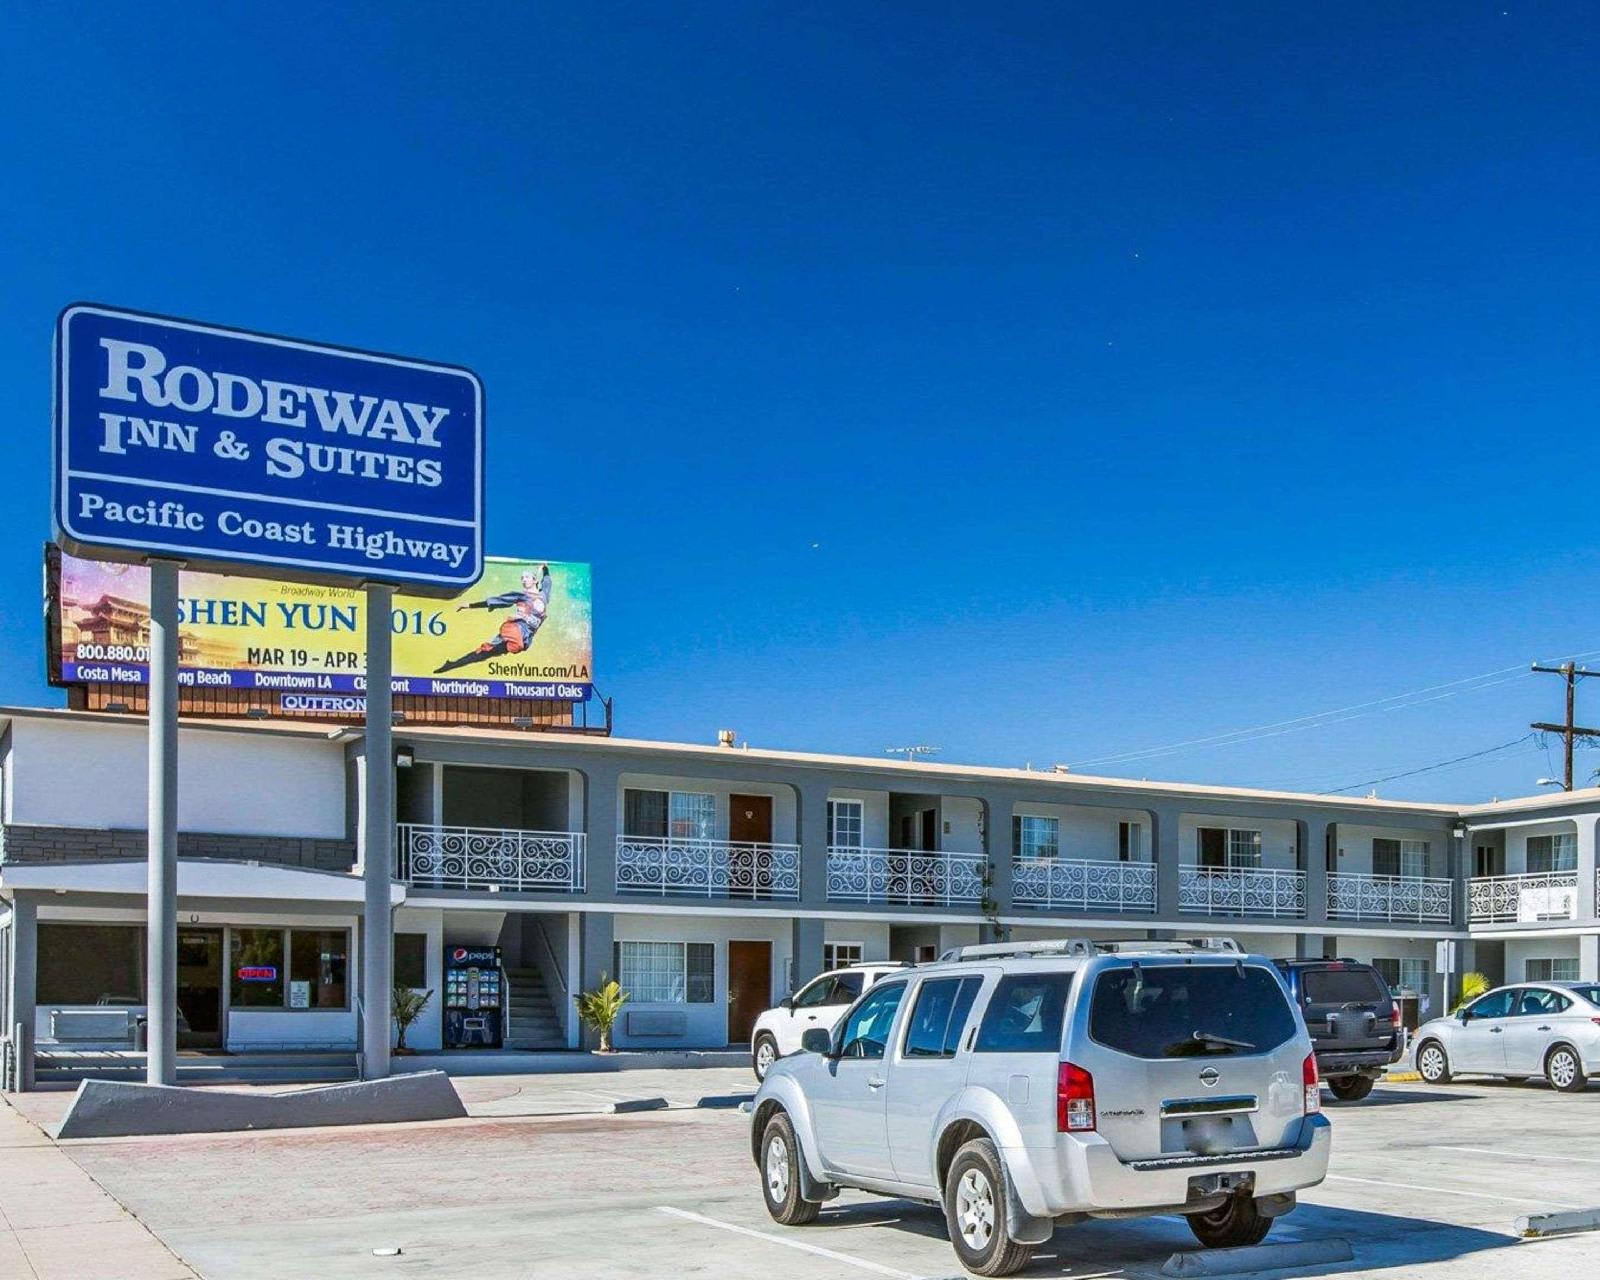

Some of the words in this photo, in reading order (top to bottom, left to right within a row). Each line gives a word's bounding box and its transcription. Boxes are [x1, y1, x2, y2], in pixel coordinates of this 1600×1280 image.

[100, 338, 449, 448] RODEWAY
[99, 412, 198, 455] INN
[213, 431, 250, 461] &
[266, 438, 442, 487] SUITES
[79, 493, 204, 531] Pacific
[218, 511, 316, 545] Coast
[327, 523, 469, 568] Highway
[280, 585, 327, 598] Broadway
[329, 587, 355, 599] World
[276, 602, 358, 632] YUN
[391, 609, 447, 636] 016
[77, 643, 151, 662] 800.880.01
[247, 647, 284, 666] MAR
[290, 649, 308, 667] 19
[324, 651, 358, 669] APR
[488, 662, 588, 679] ShenYun.com/LA
[77, 666, 109, 680] Costa
[111, 667, 142, 682] Mesa
[197, 670, 232, 685] Beach
[255, 672, 315, 688] Downtown
[318, 676, 332, 689] LA
[431, 680, 489, 697] Northridge
[505, 683, 555, 698] Thousand
[557, 684, 583, 698] Oaks
[285, 696, 367, 711] OUTFRON
[468, 951, 495, 961] pepsi
